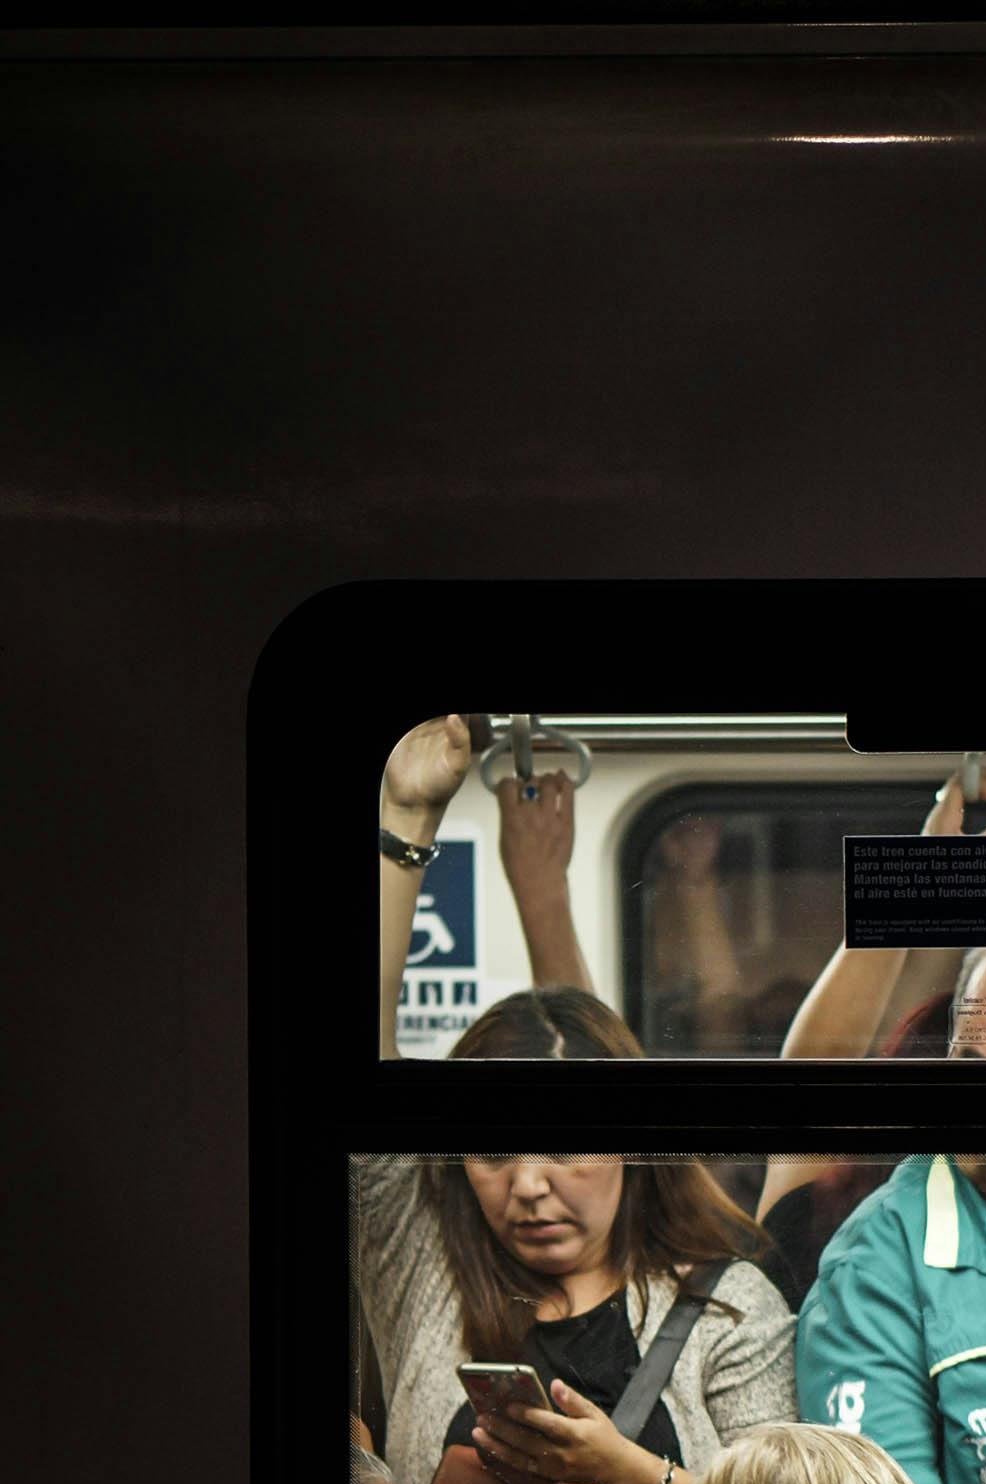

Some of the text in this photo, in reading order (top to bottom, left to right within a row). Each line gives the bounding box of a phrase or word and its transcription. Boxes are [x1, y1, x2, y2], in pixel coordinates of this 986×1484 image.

[854, 846, 879, 857] Este
[881, 846, 905, 857] tren
[908, 845, 947, 856] cuenta
[950, 847, 972, 856] con
[854, 861, 880, 872] para
[882, 859, 928, 873] mejorar
[931, 859, 948, 871] las
[854, 873, 911, 887] Mantenga
[913, 873, 932, 885] las
[934, 873, 986, 884] ventanas
[854, 887, 865, 898] el
[867, 887, 890, 898] aire
[893, 886, 918, 899] esté
[921, 888, 935, 898] en
